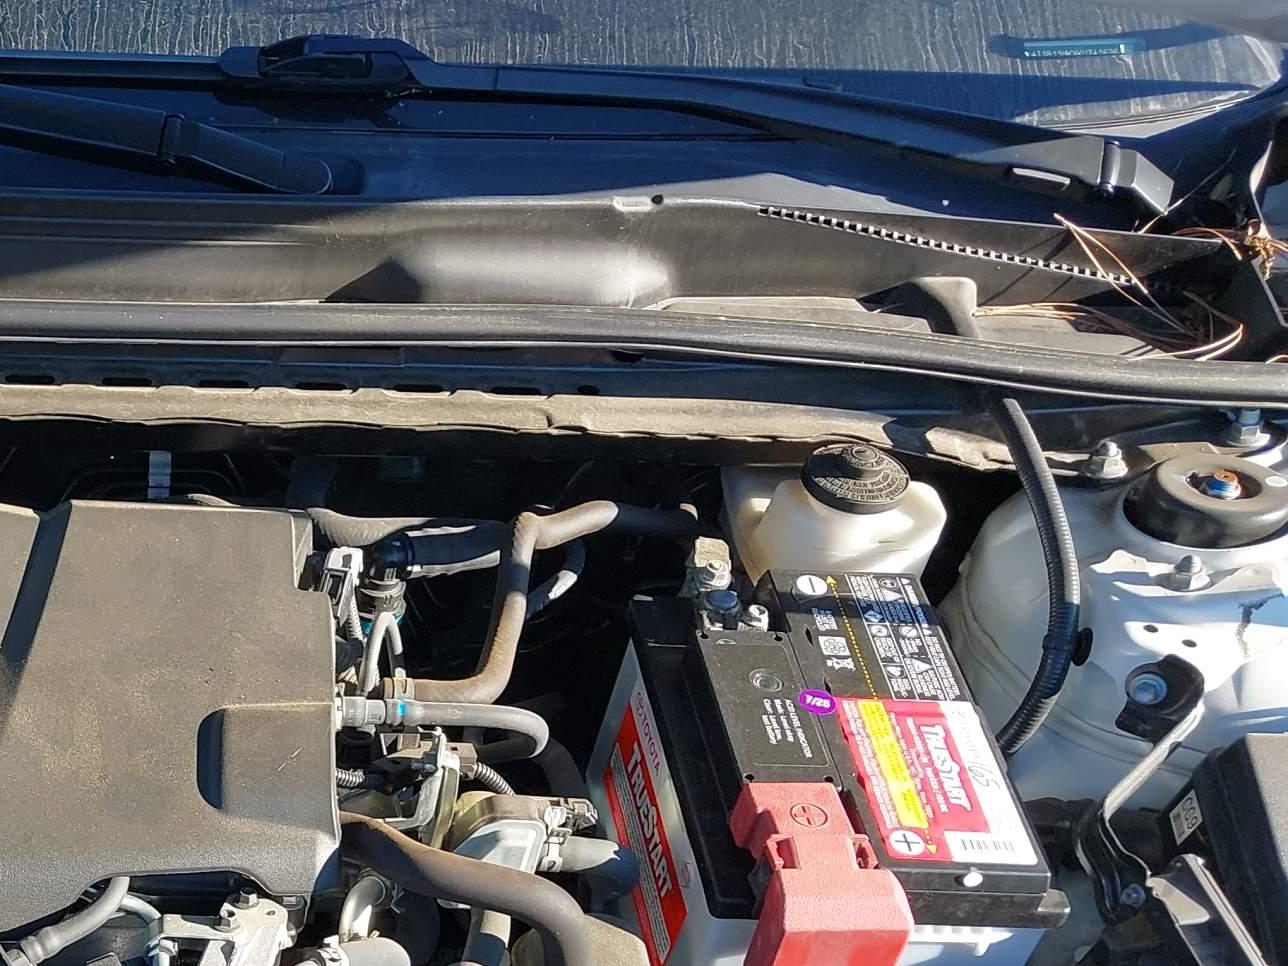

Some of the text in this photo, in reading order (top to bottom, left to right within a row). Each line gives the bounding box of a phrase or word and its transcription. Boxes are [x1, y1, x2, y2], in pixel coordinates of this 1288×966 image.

[640, 717, 661, 778] TOYOTA
[783, 698, 813, 758] ACID LEVEL INDICATOR
[627, 741, 673, 898] TRUESTART
